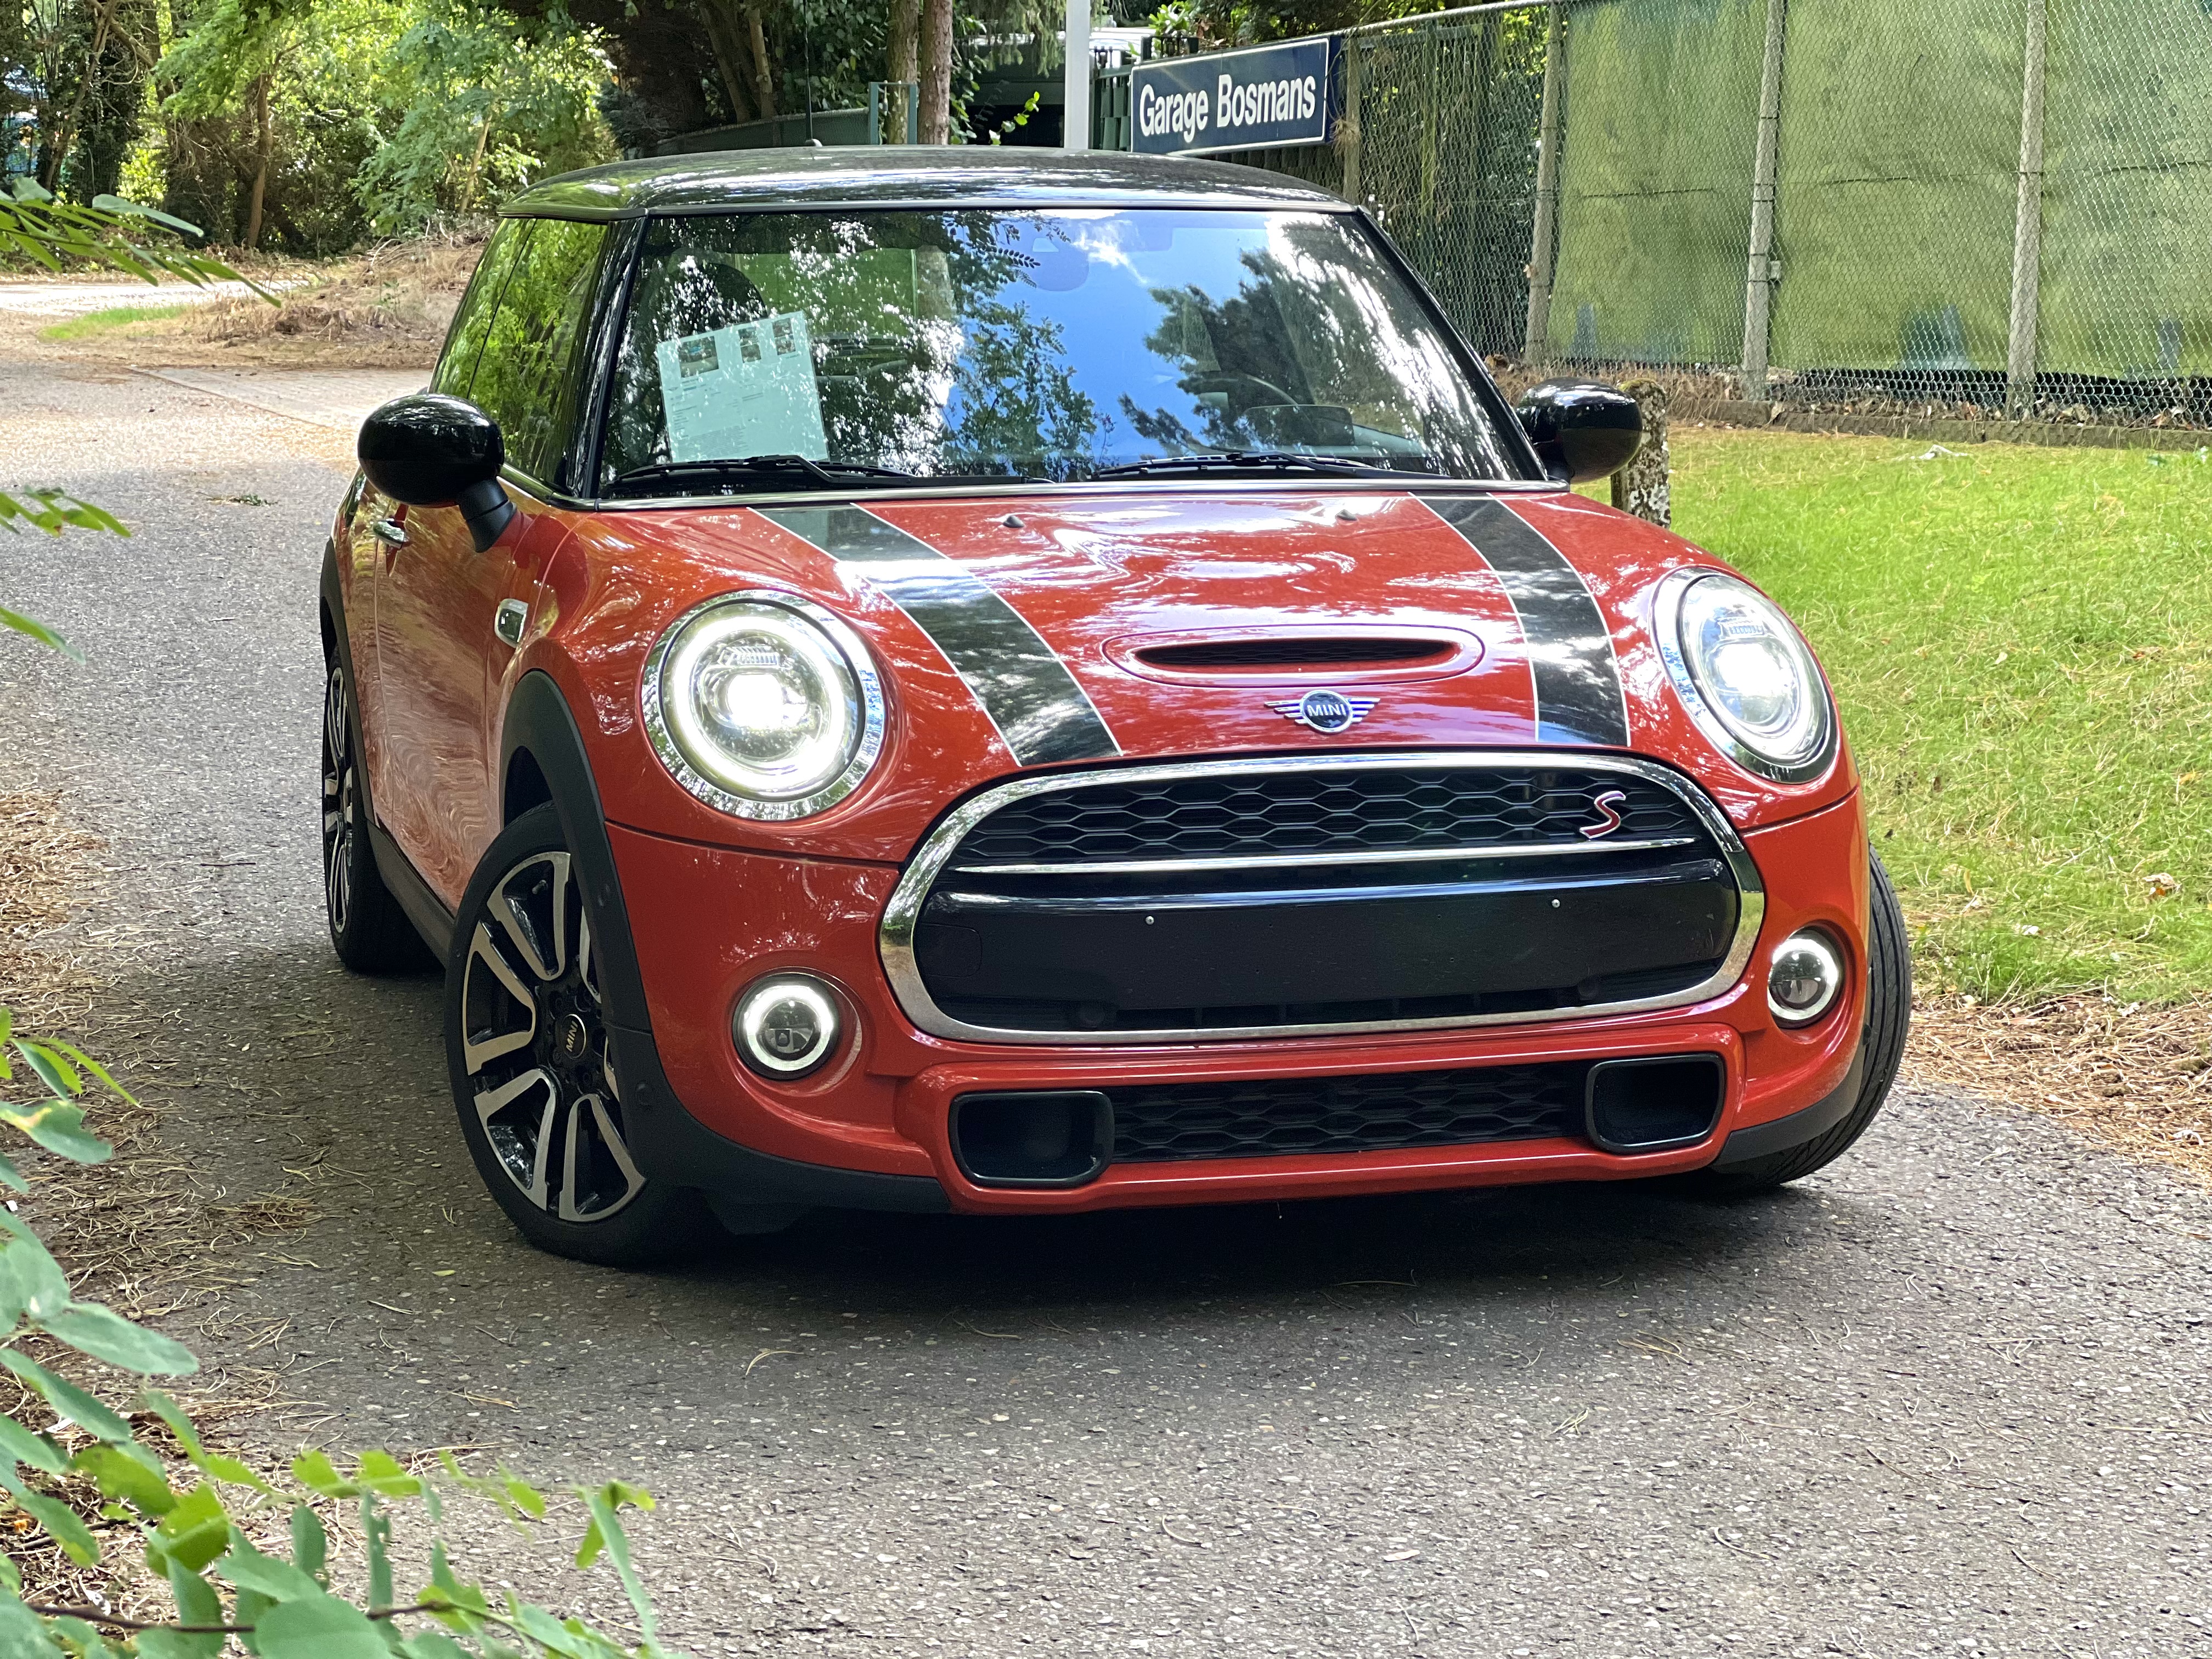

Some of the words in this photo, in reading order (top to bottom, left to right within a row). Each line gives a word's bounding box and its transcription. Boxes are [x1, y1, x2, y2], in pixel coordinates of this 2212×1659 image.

[1139, 84, 1209, 143] Garage
[1217, 74, 1316, 128] Bosmans
[1307, 703, 1347, 716] MINI
[1579, 790, 1627, 839] S
[566, 1020, 578, 1052] MINI
